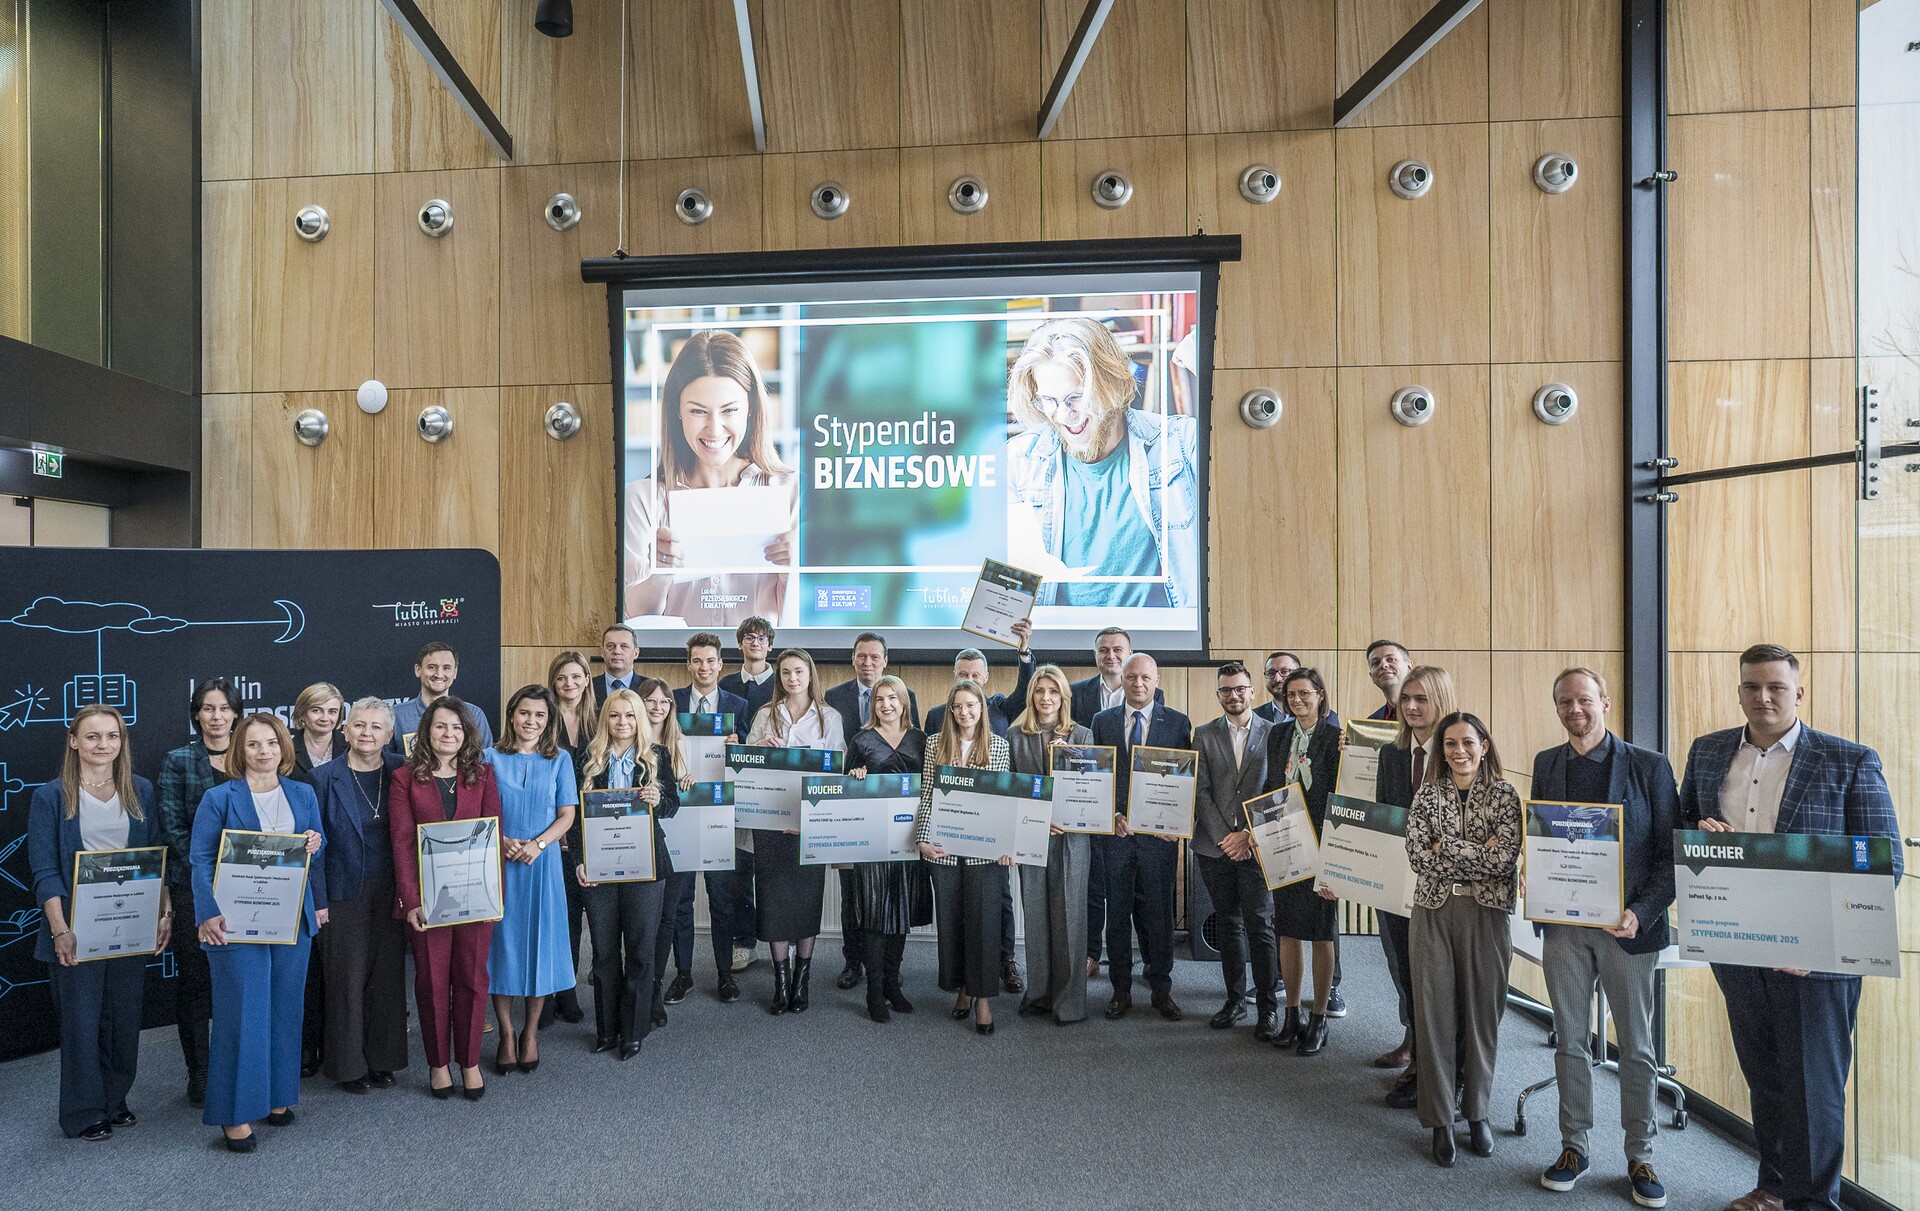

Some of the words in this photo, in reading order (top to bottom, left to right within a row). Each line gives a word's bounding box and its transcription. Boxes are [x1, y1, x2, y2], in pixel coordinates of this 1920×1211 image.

[814, 411, 955, 454] Stypendia
[814, 454, 996, 490] BIZNESOWE
[730, 754, 765, 764] VOUCHER
[940, 775, 974, 787] VOUCHER
[807, 785, 843, 794] VOUCHER
[1331, 804, 1366, 822] VOUCHER
[960, 833, 984, 842] BIZNESOWE
[1683, 844, 1744, 860] VOUCHER
[1324, 869, 1346, 880] STYPENDIA
[1347, 875, 1372, 887] BIZNESOWE
[1373, 881, 1384, 890] 2025
[1691, 929, 1732, 939] STYPENDIA
[1734, 932, 1778, 943] BIZNESOWE
[1780, 936, 1799, 944] 2025
